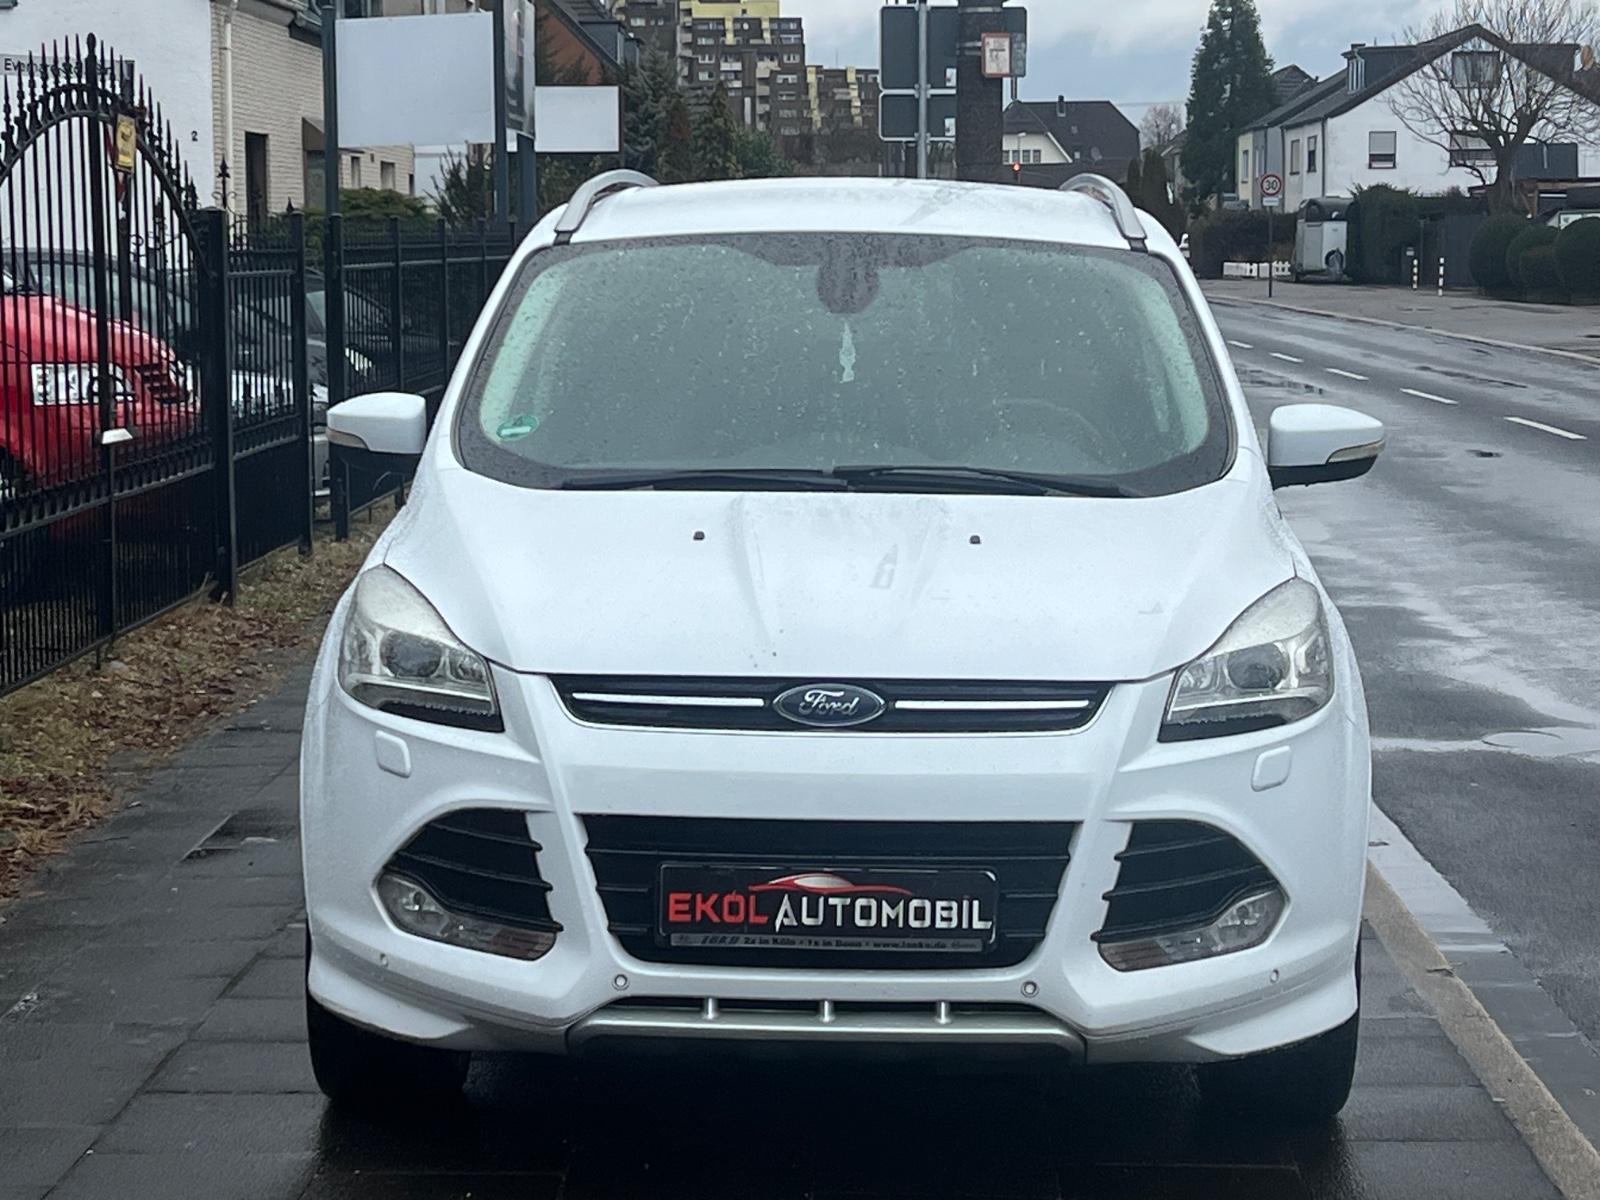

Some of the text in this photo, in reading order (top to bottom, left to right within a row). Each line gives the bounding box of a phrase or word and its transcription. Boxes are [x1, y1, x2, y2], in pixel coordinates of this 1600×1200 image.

[190, 130, 199, 142] 2
[1264, 179, 1278, 191] 30
[799, 689, 860, 716] Ford
